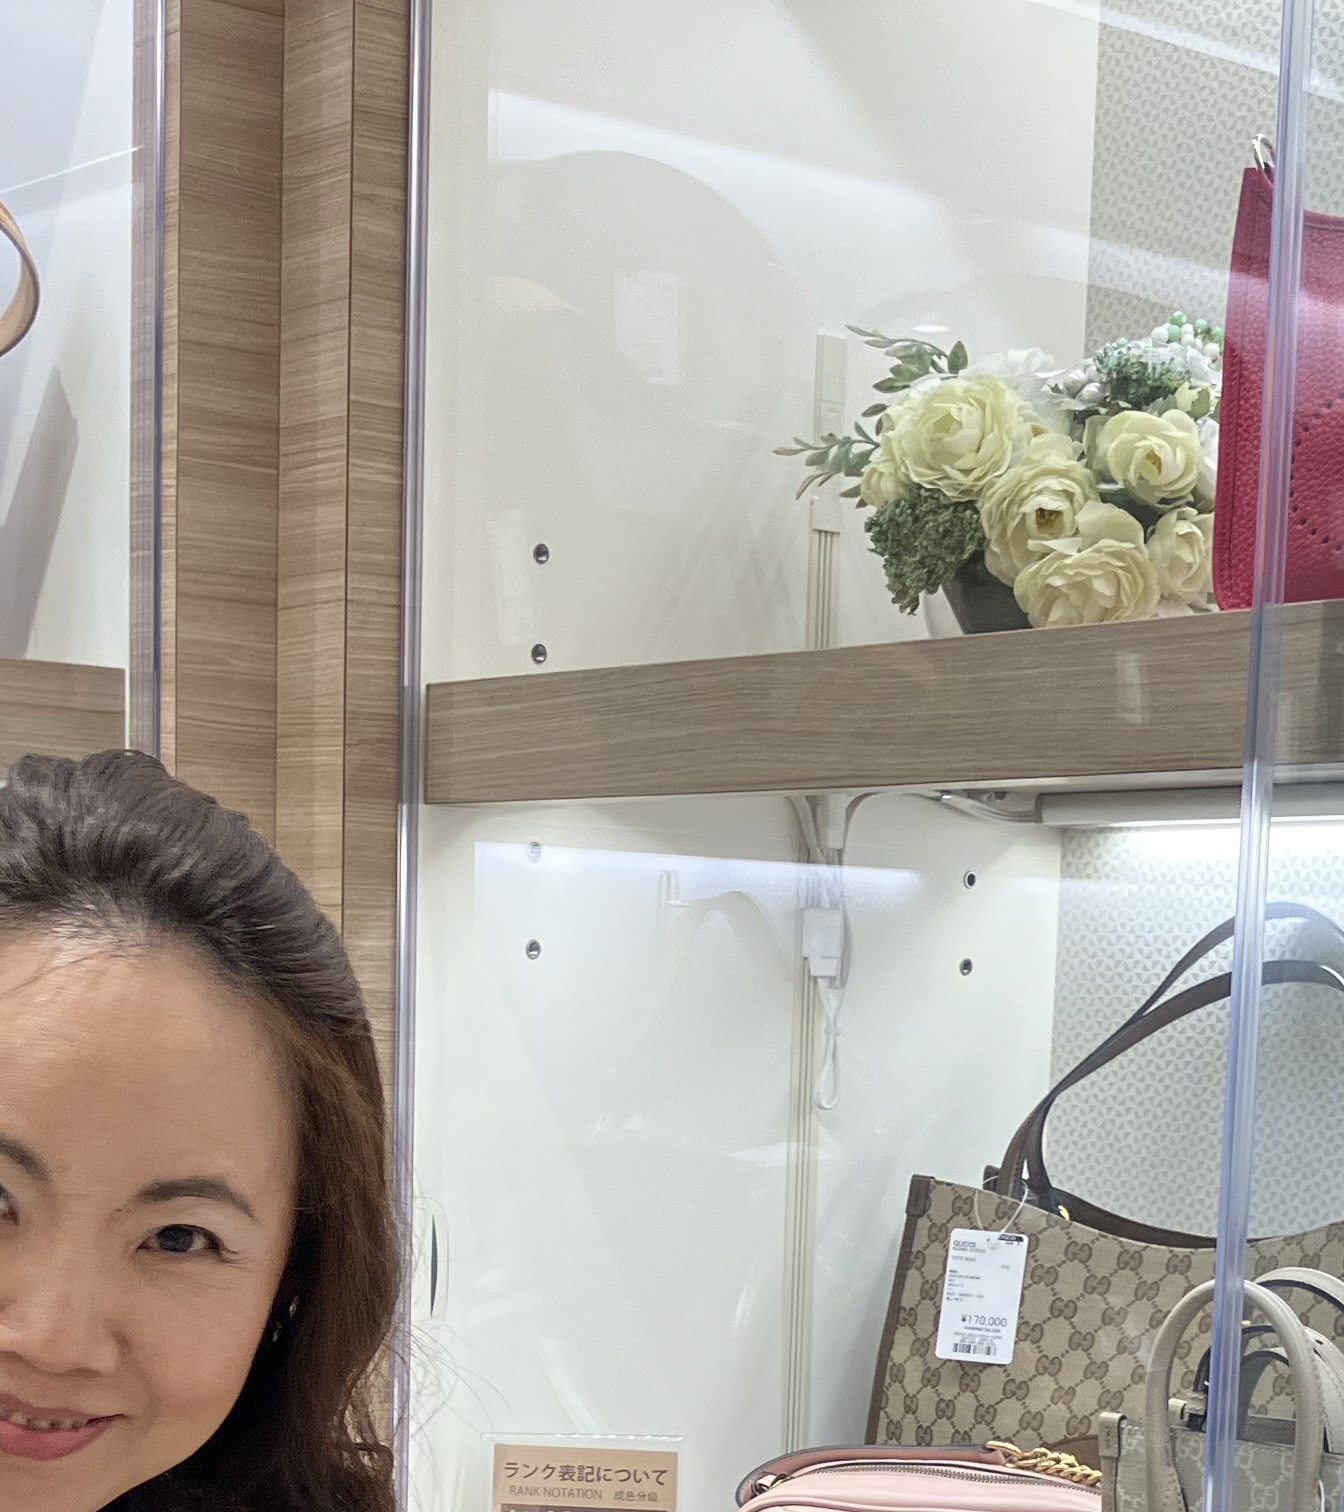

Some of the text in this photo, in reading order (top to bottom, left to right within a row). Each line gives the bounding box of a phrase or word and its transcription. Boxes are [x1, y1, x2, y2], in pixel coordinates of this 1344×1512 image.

[953, 1240, 976, 1248] GUCCI
[961, 1314, 1007, 1328] ¥170,000
[504, 1462, 668, 1486] ランク表記について
[509, 1485, 540, 1497] RANK
[543, 1487, 602, 1500] NOTATION
